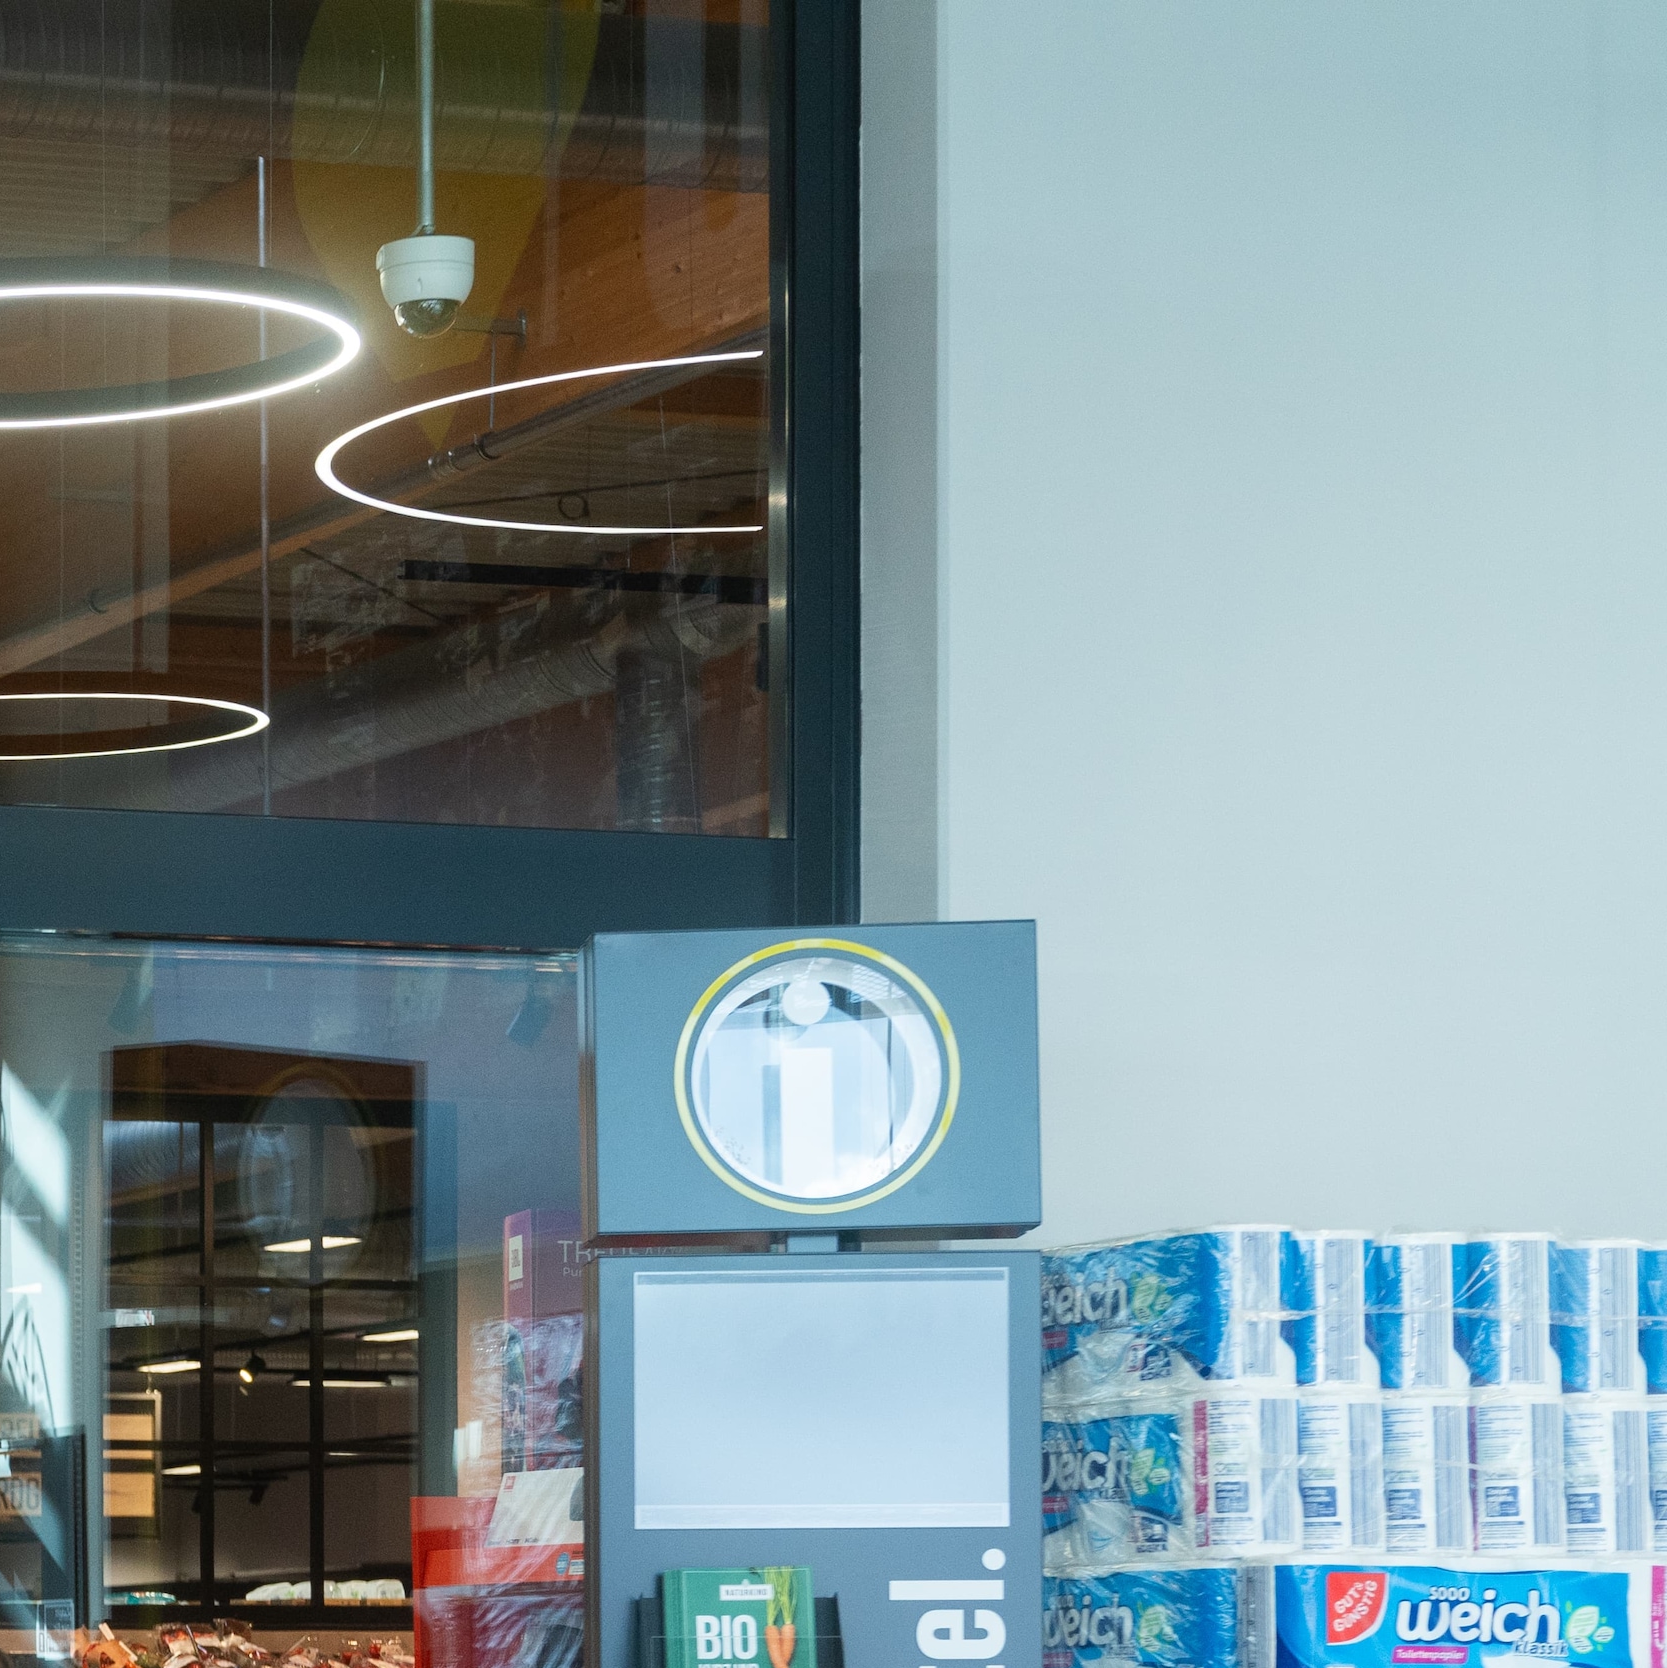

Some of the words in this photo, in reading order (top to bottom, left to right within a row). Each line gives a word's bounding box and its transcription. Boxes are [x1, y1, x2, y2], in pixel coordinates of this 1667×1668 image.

[1331, 1579, 1379, 1634] GÜNSTIG
[1395, 1587, 1561, 1644] weich
[695, 1614, 758, 1660] BIO
[1395, 1648, 1466, 1663] Toilettenpapier
[1513, 1636, 1569, 1657] klassik
